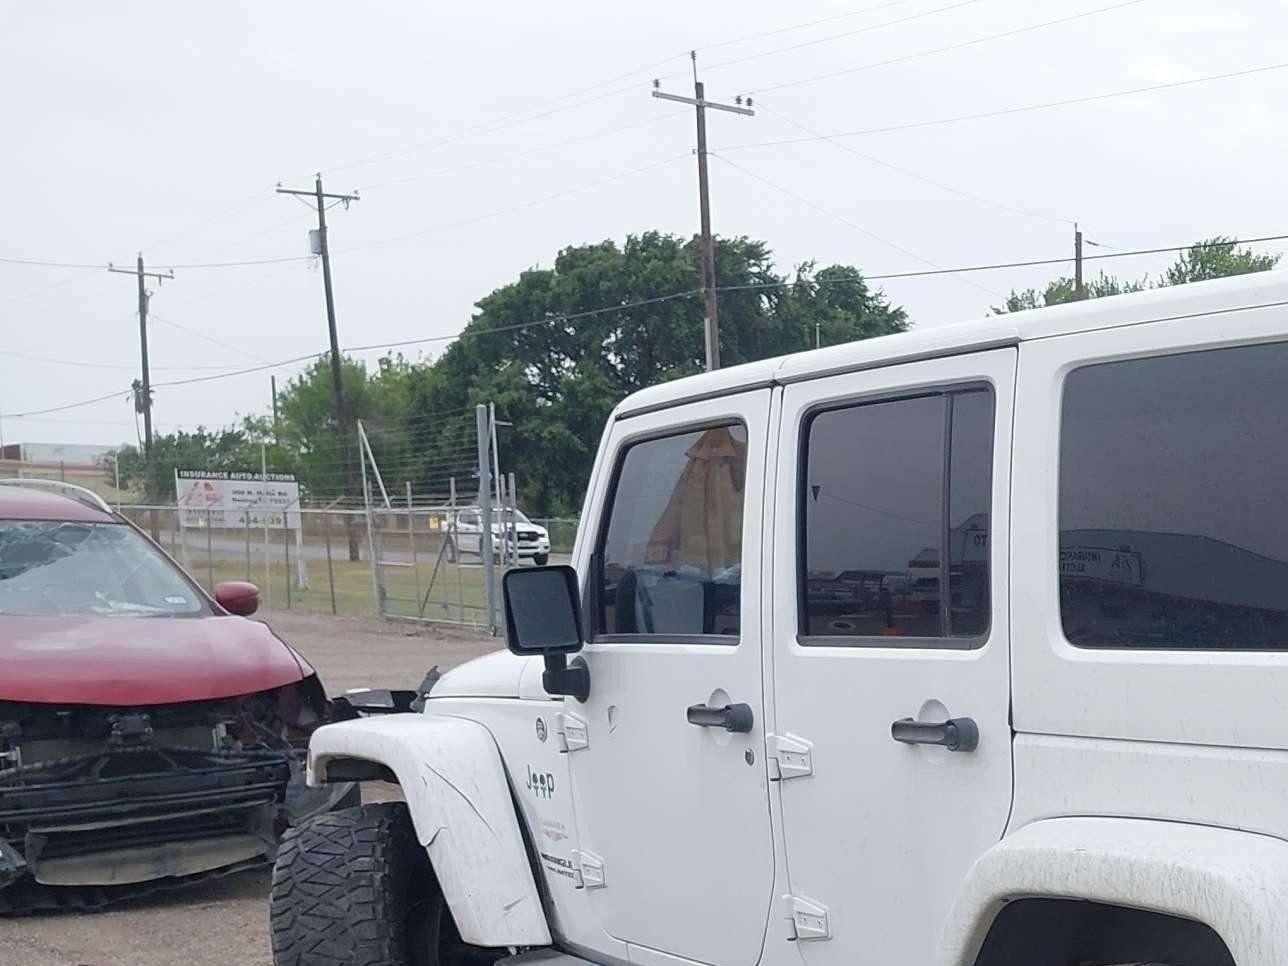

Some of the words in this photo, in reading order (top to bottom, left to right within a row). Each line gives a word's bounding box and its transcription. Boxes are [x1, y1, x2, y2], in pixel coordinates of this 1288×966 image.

[180, 470, 229, 479] INSURANCE
[230, 472, 253, 480] AUTO
[254, 473, 296, 481] AUCTIONS
